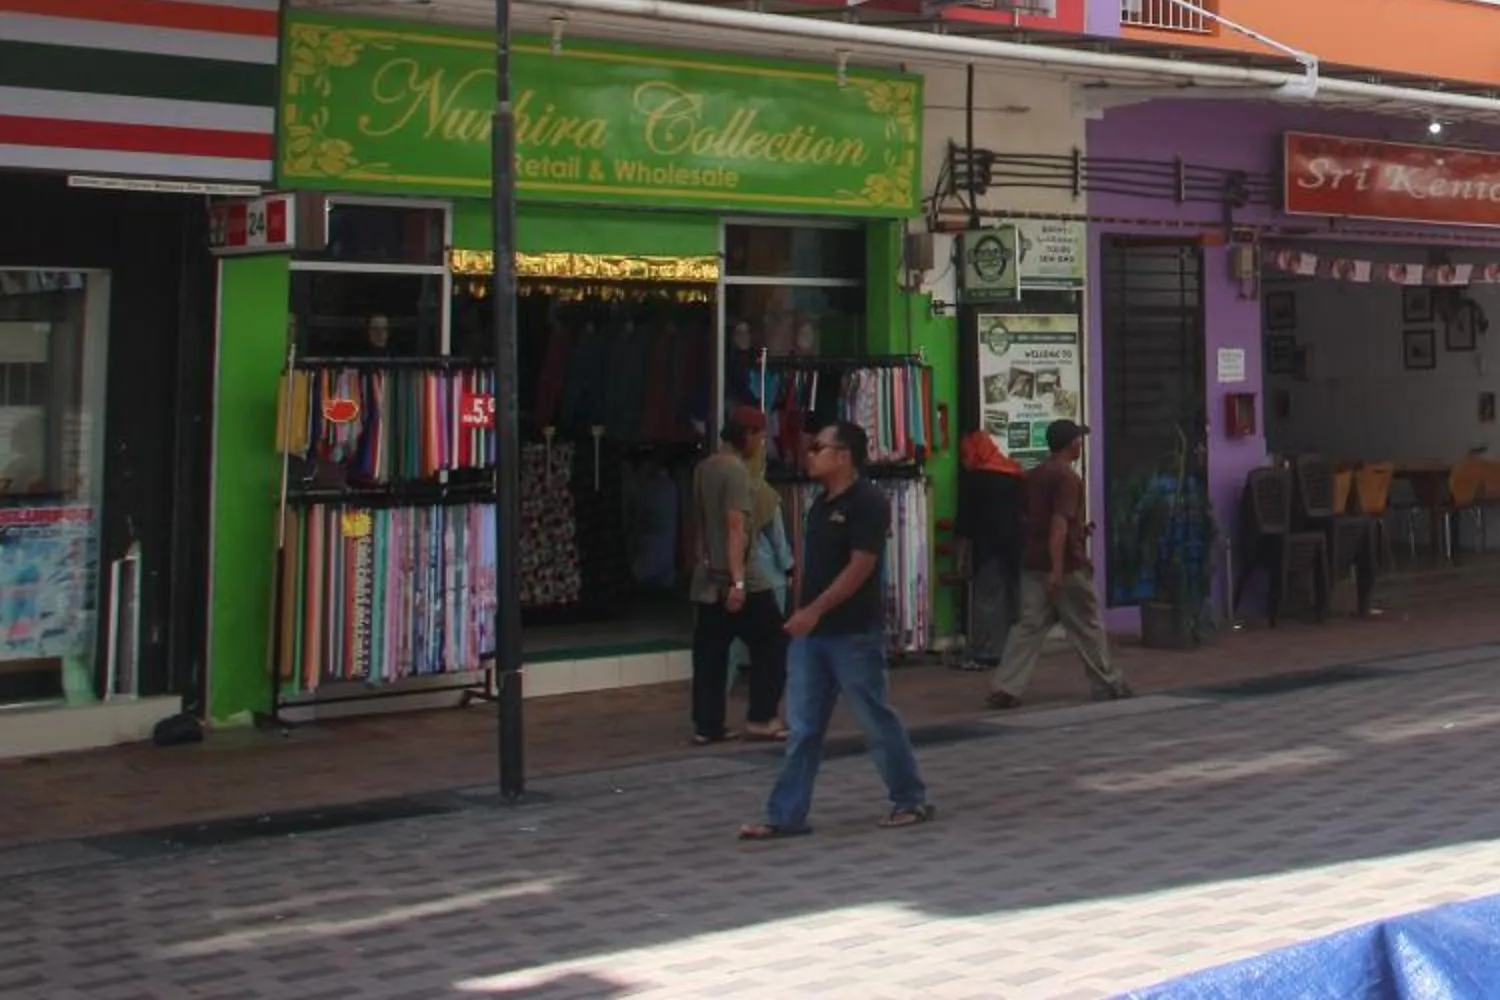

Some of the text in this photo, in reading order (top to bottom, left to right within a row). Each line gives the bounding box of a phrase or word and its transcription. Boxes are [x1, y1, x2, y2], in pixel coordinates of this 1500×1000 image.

[633, 80, 865, 168] Collection
[588, 159, 604, 182] &
[613, 158, 740, 188] Wholesale
[1297, 157, 1371, 192] Sri
[247, 211, 266, 237] 24
